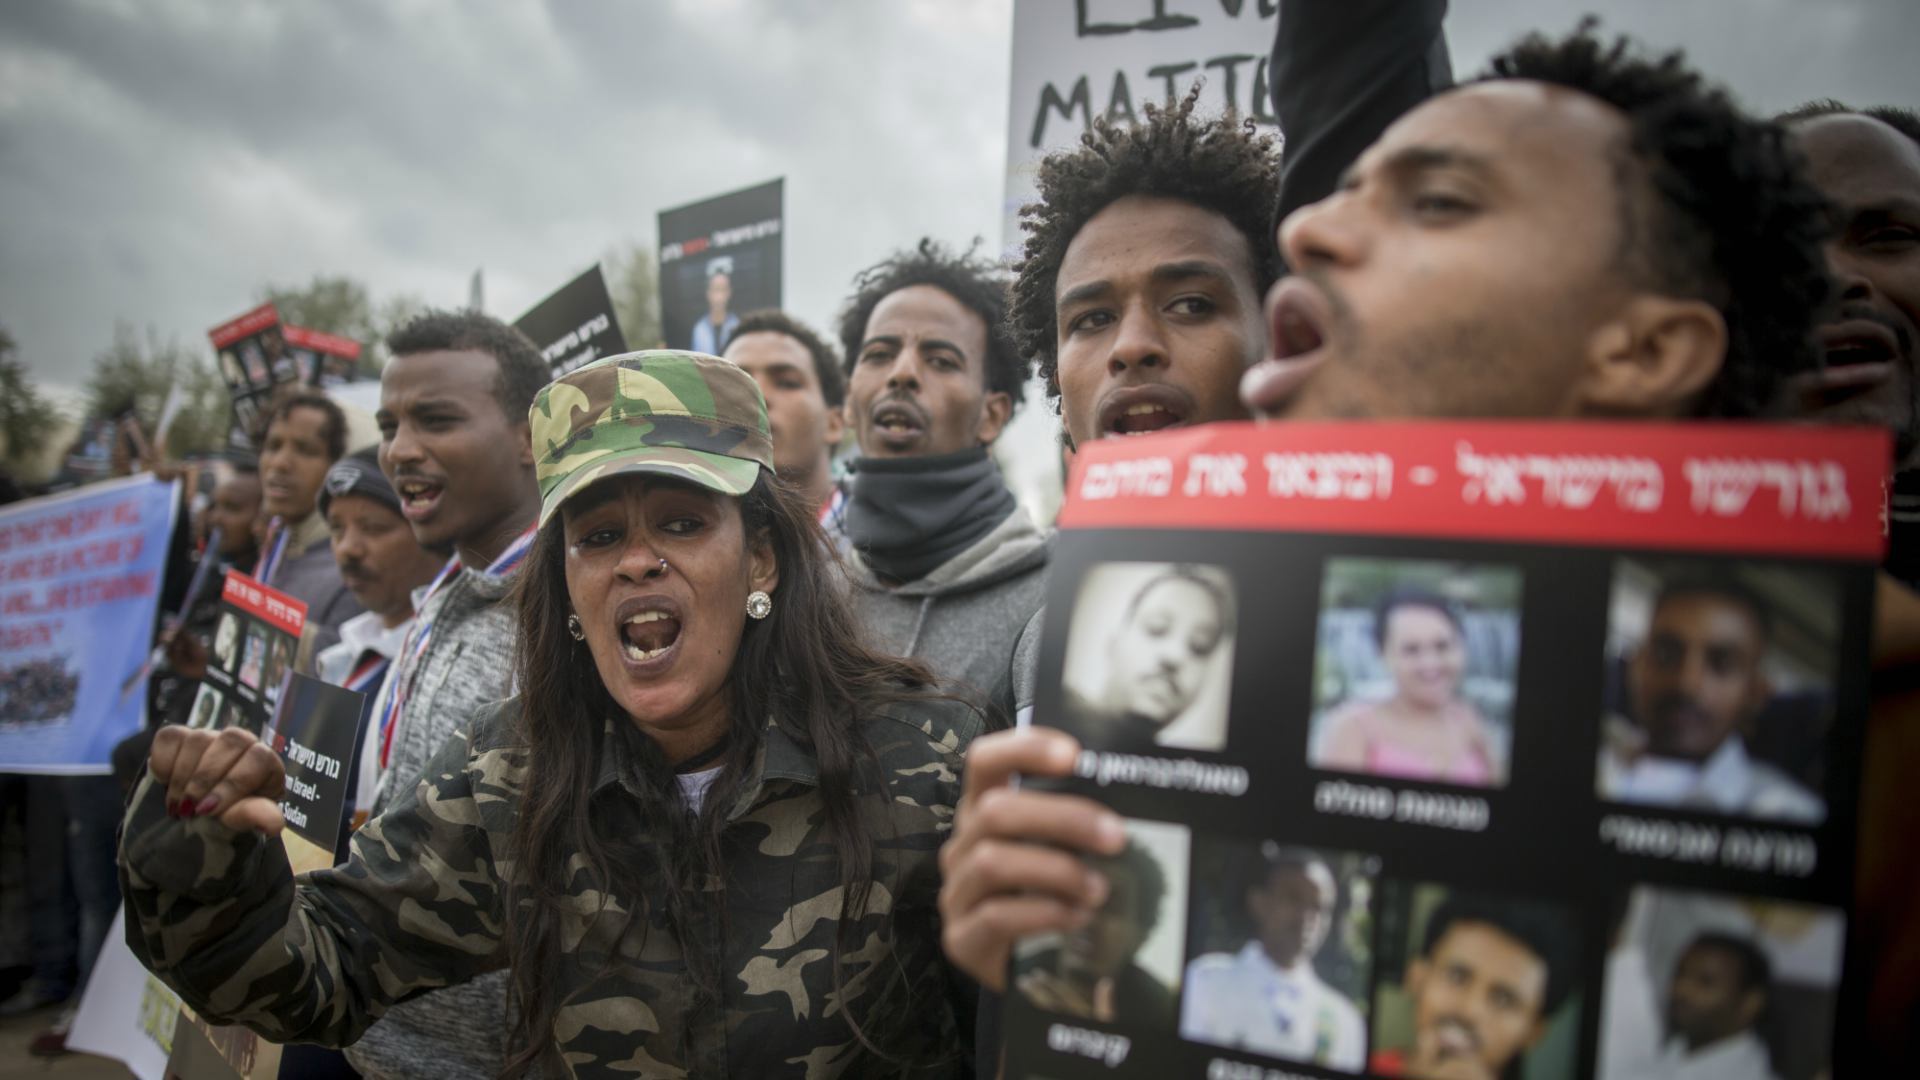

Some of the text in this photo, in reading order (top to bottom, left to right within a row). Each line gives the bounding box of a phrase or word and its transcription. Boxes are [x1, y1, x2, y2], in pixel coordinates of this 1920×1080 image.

[1184, 453, 1248, 497] את
[1456, 440, 1663, 512] מישראל
[1684, 457, 1852, 521] גורשו
[287, 737, 316, 769] מישראל
[315, 753, 340, 779] גורש
[292, 776, 317, 801] Israel
[283, 801, 307, 828] Sudan
